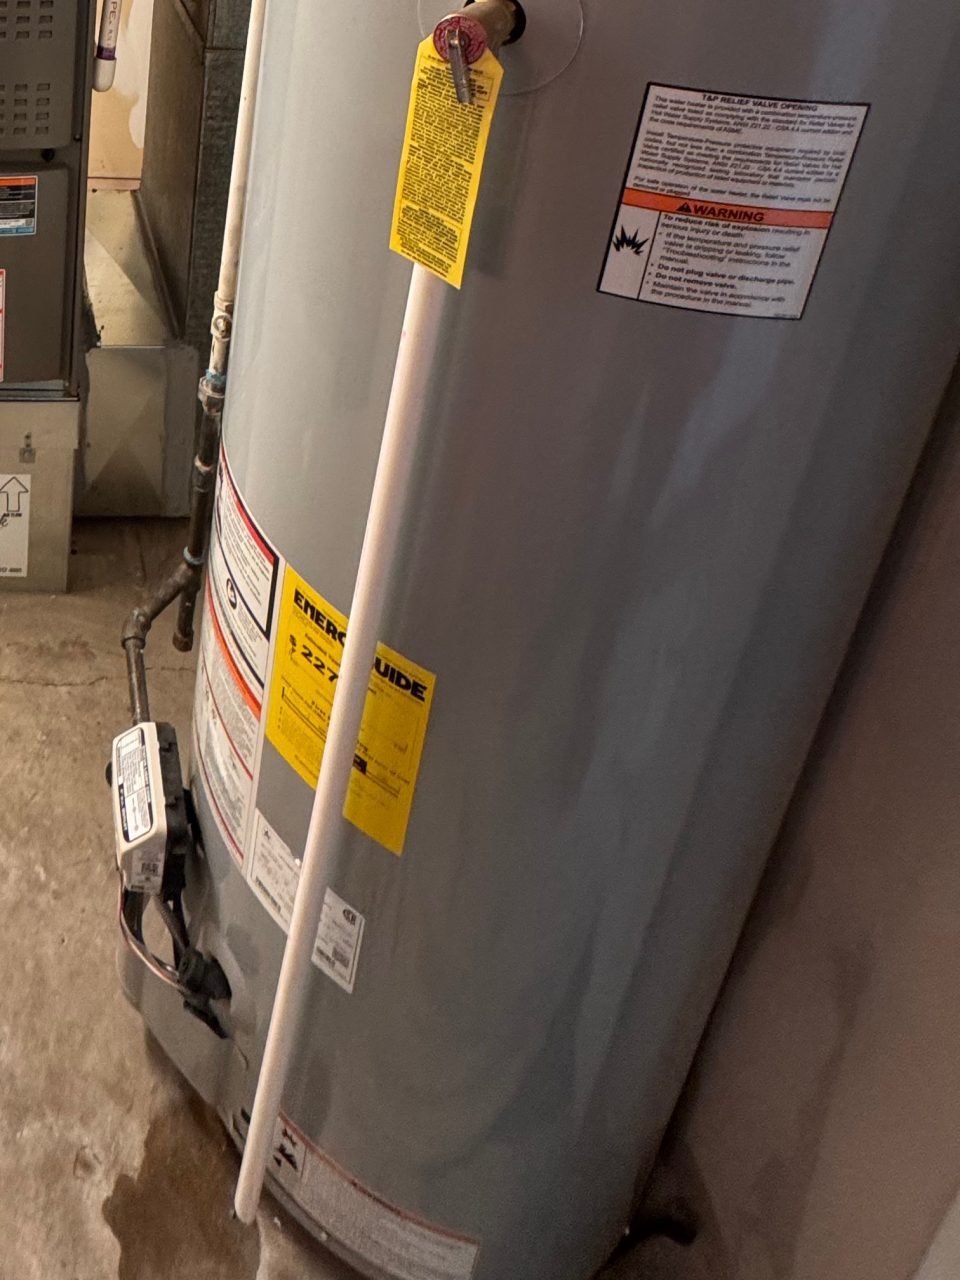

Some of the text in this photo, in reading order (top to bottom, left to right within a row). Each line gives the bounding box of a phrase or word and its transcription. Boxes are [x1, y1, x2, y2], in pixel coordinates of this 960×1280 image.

[719, 96, 750, 105] RELIEF
[751, 100, 778, 108] VALVE
[779, 102, 818, 112] OPENING
[692, 204, 765, 222] WARNING
[660, 222, 688, 230] serious
[689, 226, 711, 235] injury
[674, 216, 703, 225] reduce
[730, 223, 770, 234] explosion
[771, 227, 802, 236] resulting
[682, 278, 713, 286] remove
[684, 268, 704, 277] plug
[737, 274, 775, 284] discharge
[301, 644, 338, 682] 227
[374, 656, 427, 702] UIDE
